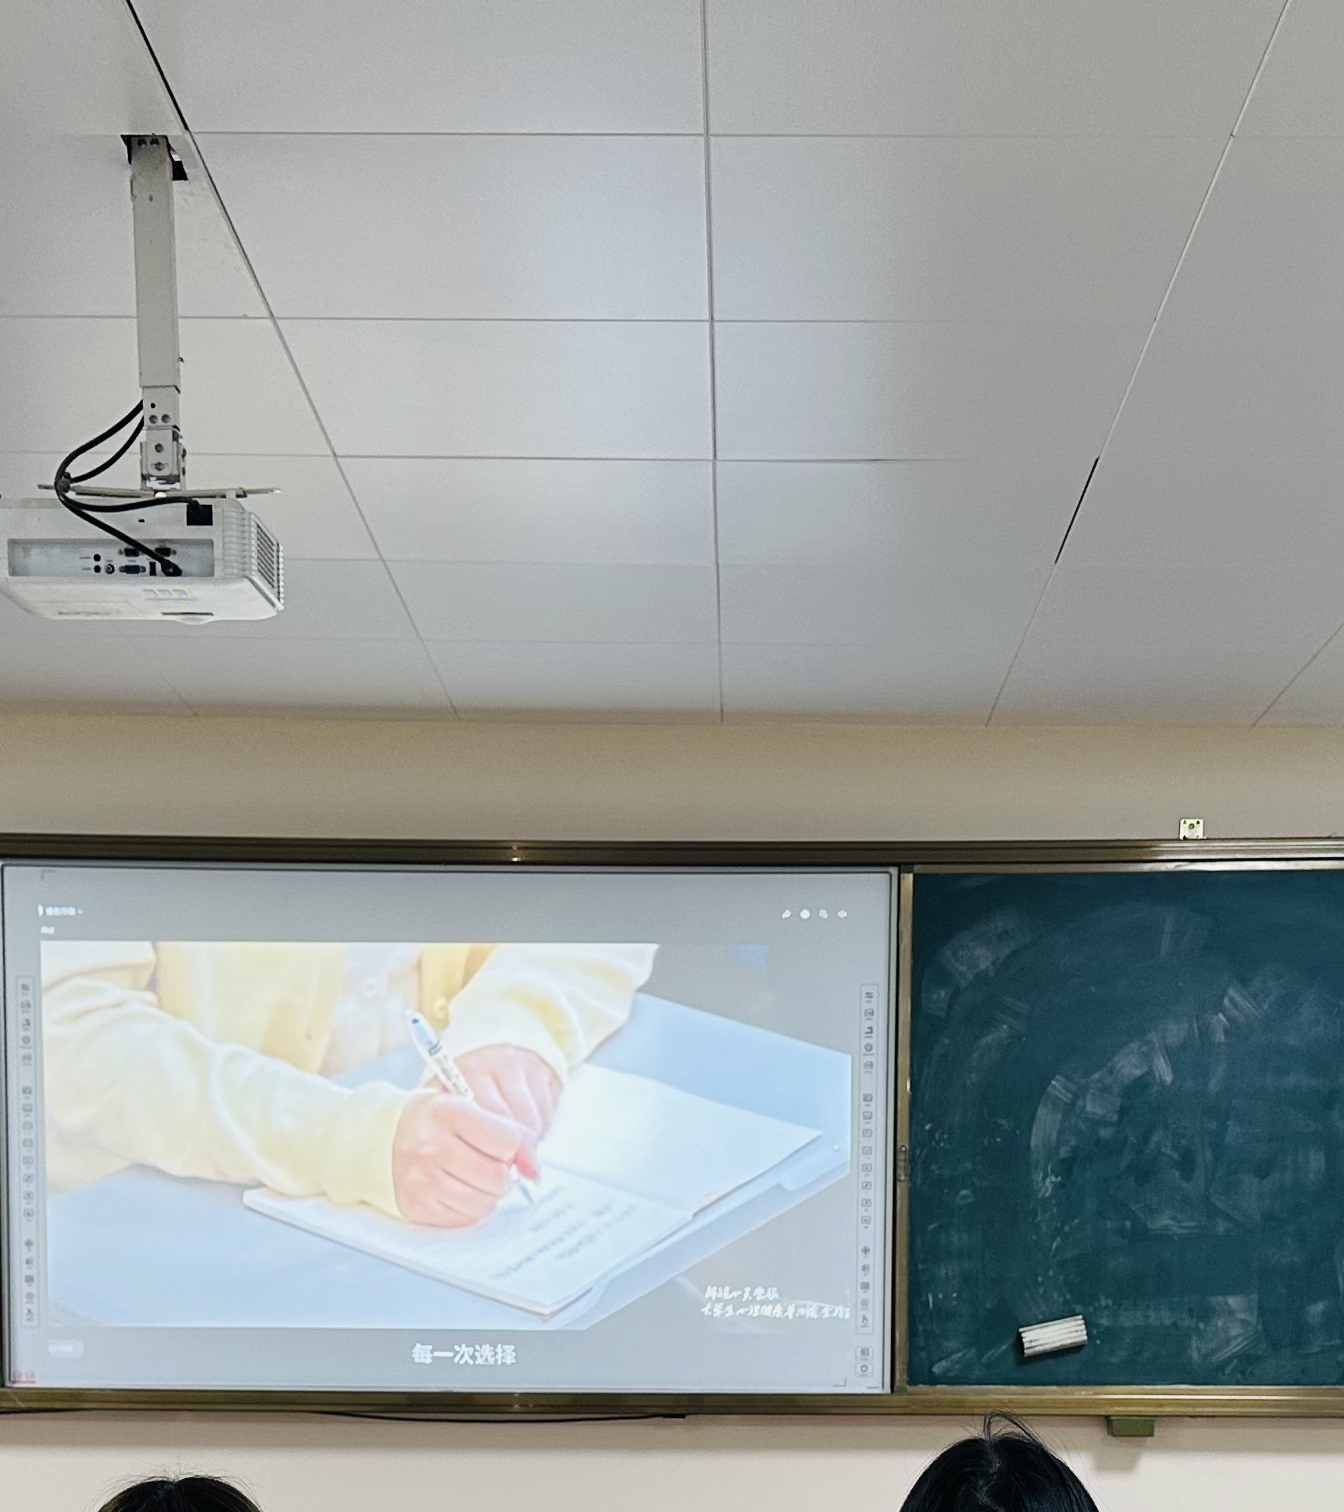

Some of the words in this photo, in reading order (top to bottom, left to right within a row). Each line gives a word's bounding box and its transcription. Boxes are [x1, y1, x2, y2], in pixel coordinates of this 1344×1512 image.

[412, 1343, 516, 1365] 每一次选择
